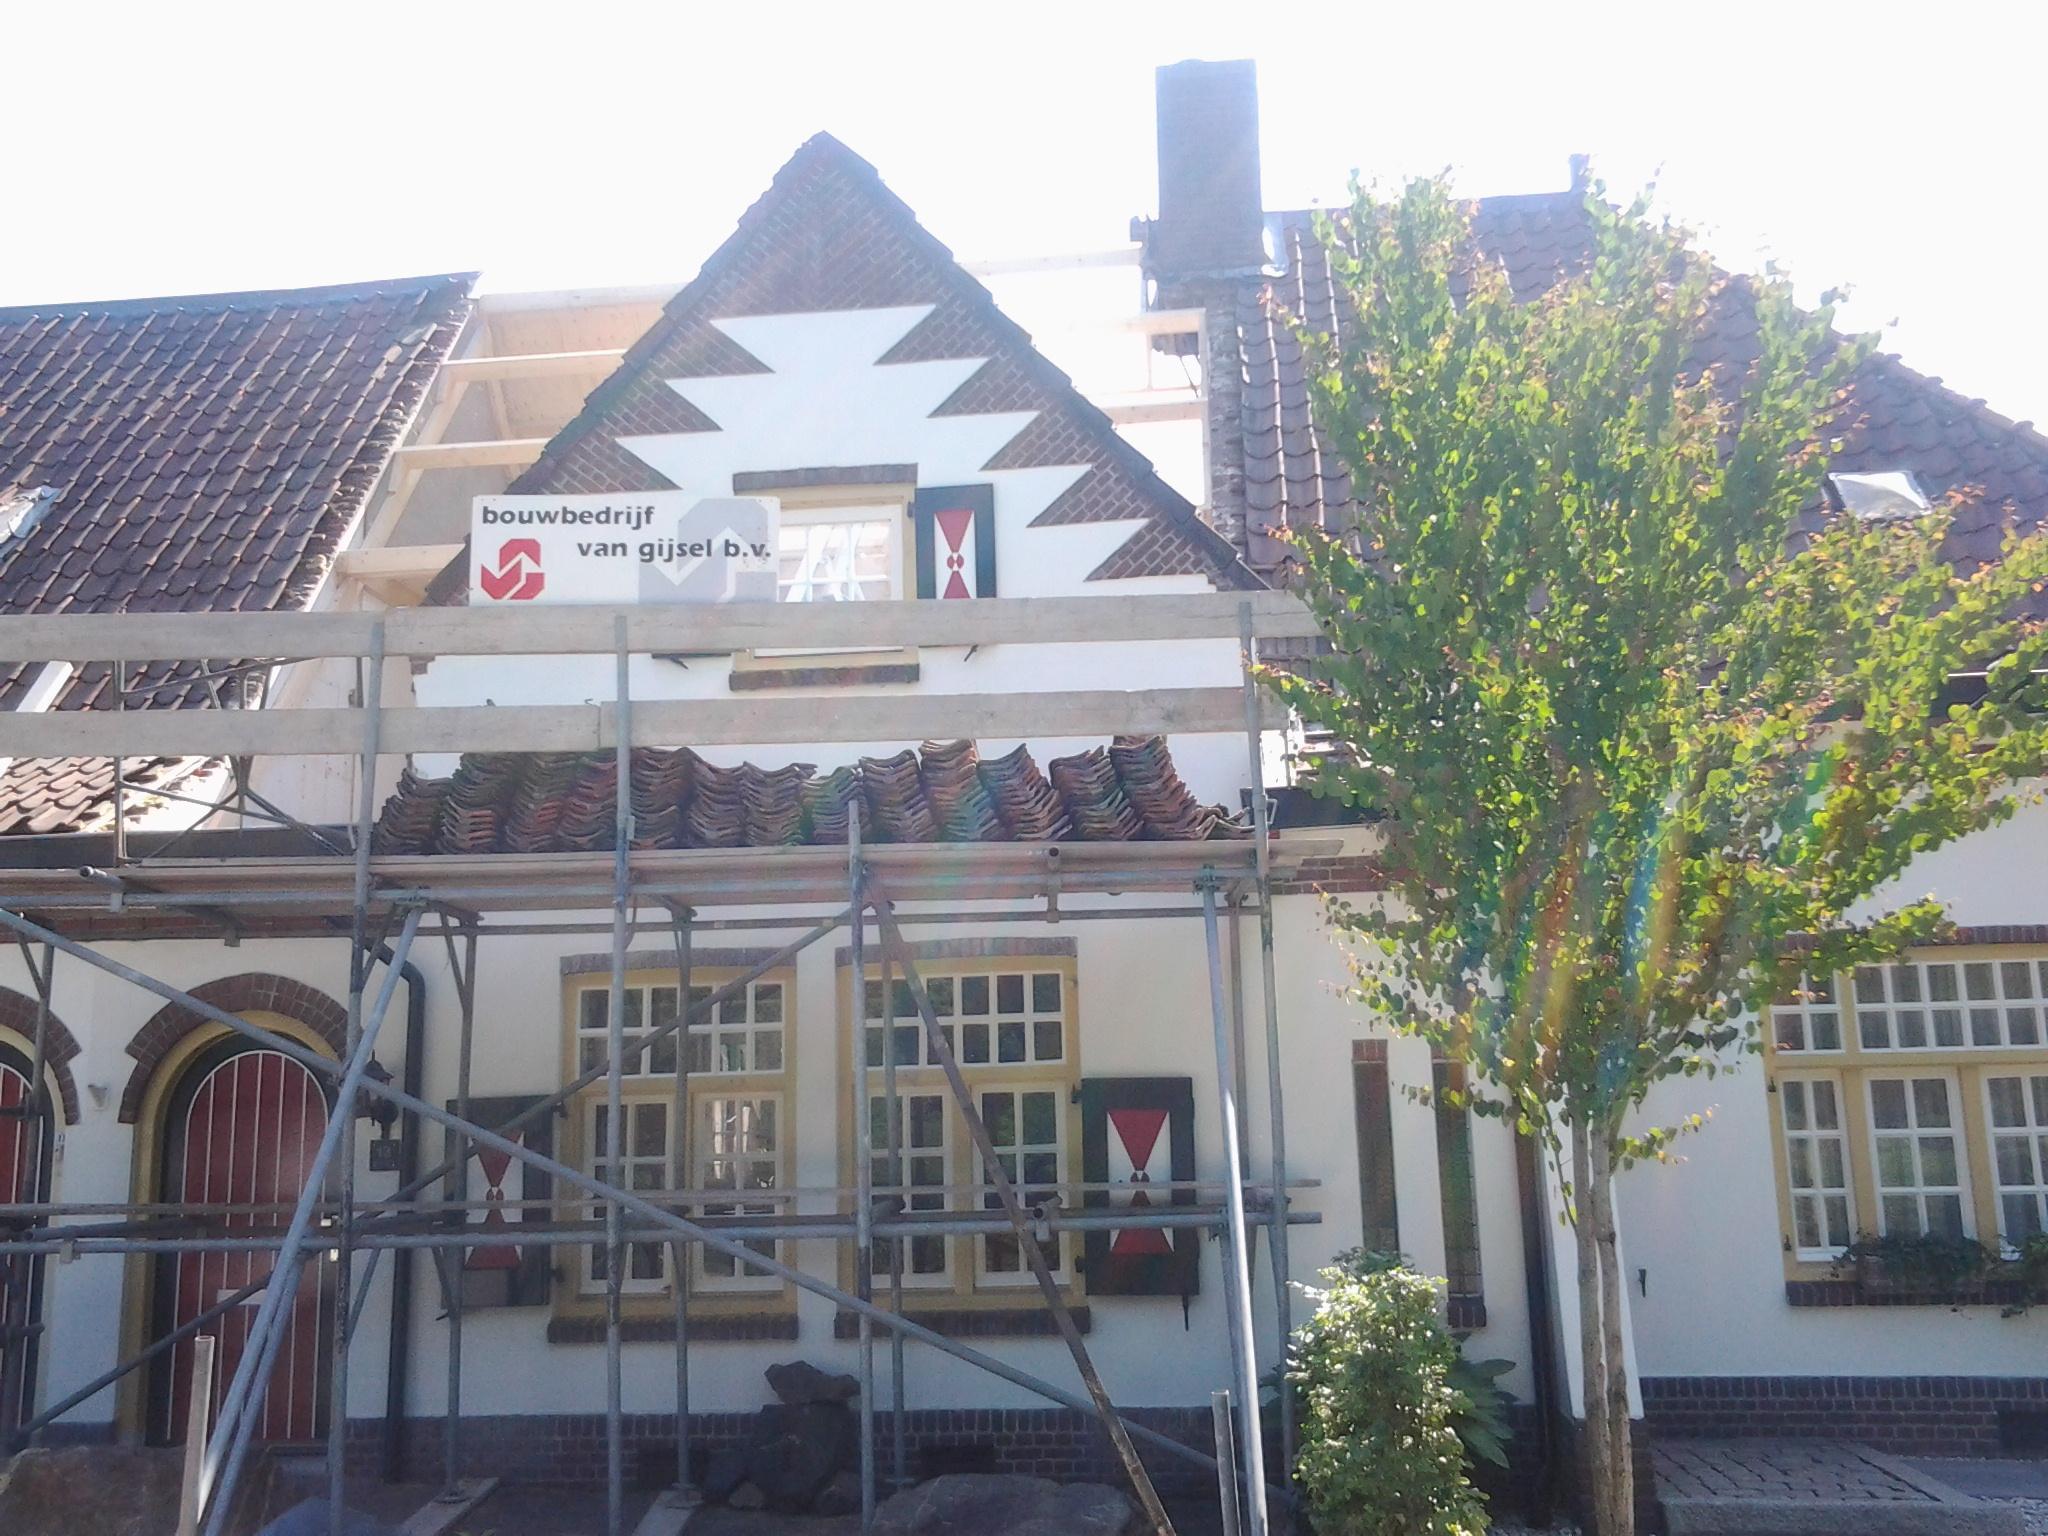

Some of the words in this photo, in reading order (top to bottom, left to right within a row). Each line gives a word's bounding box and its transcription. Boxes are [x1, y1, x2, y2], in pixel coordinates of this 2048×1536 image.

[482, 506, 655, 530] bouwbedrijf
[577, 543, 627, 557] van
[639, 538, 712, 563] gijsel
[724, 539, 771, 557] b.v.
